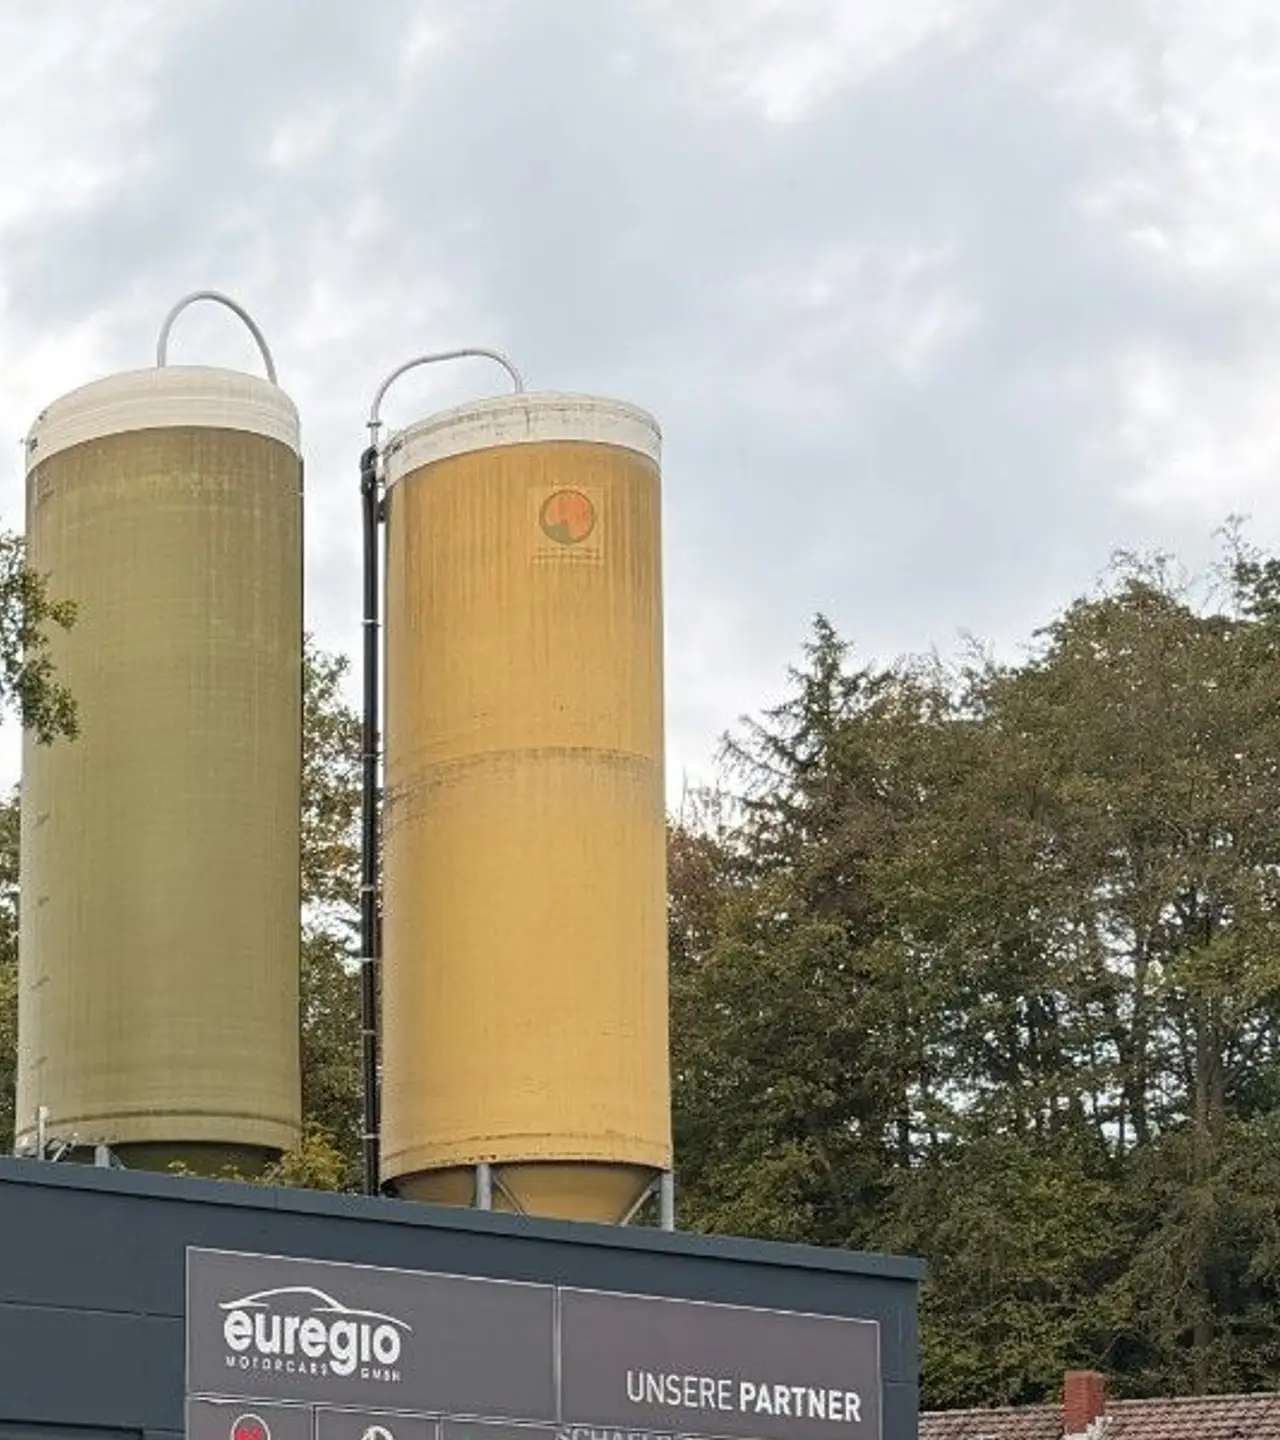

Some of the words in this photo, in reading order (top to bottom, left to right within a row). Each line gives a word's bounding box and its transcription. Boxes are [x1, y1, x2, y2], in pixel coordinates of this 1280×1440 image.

[223, 1309, 401, 1377] euregio
[225, 1355, 328, 1377] MOTORCARS
[360, 1367, 401, 1382] GMBH
[626, 1370, 733, 1411] UNSERE
[740, 1381, 862, 1423] PARTNER
